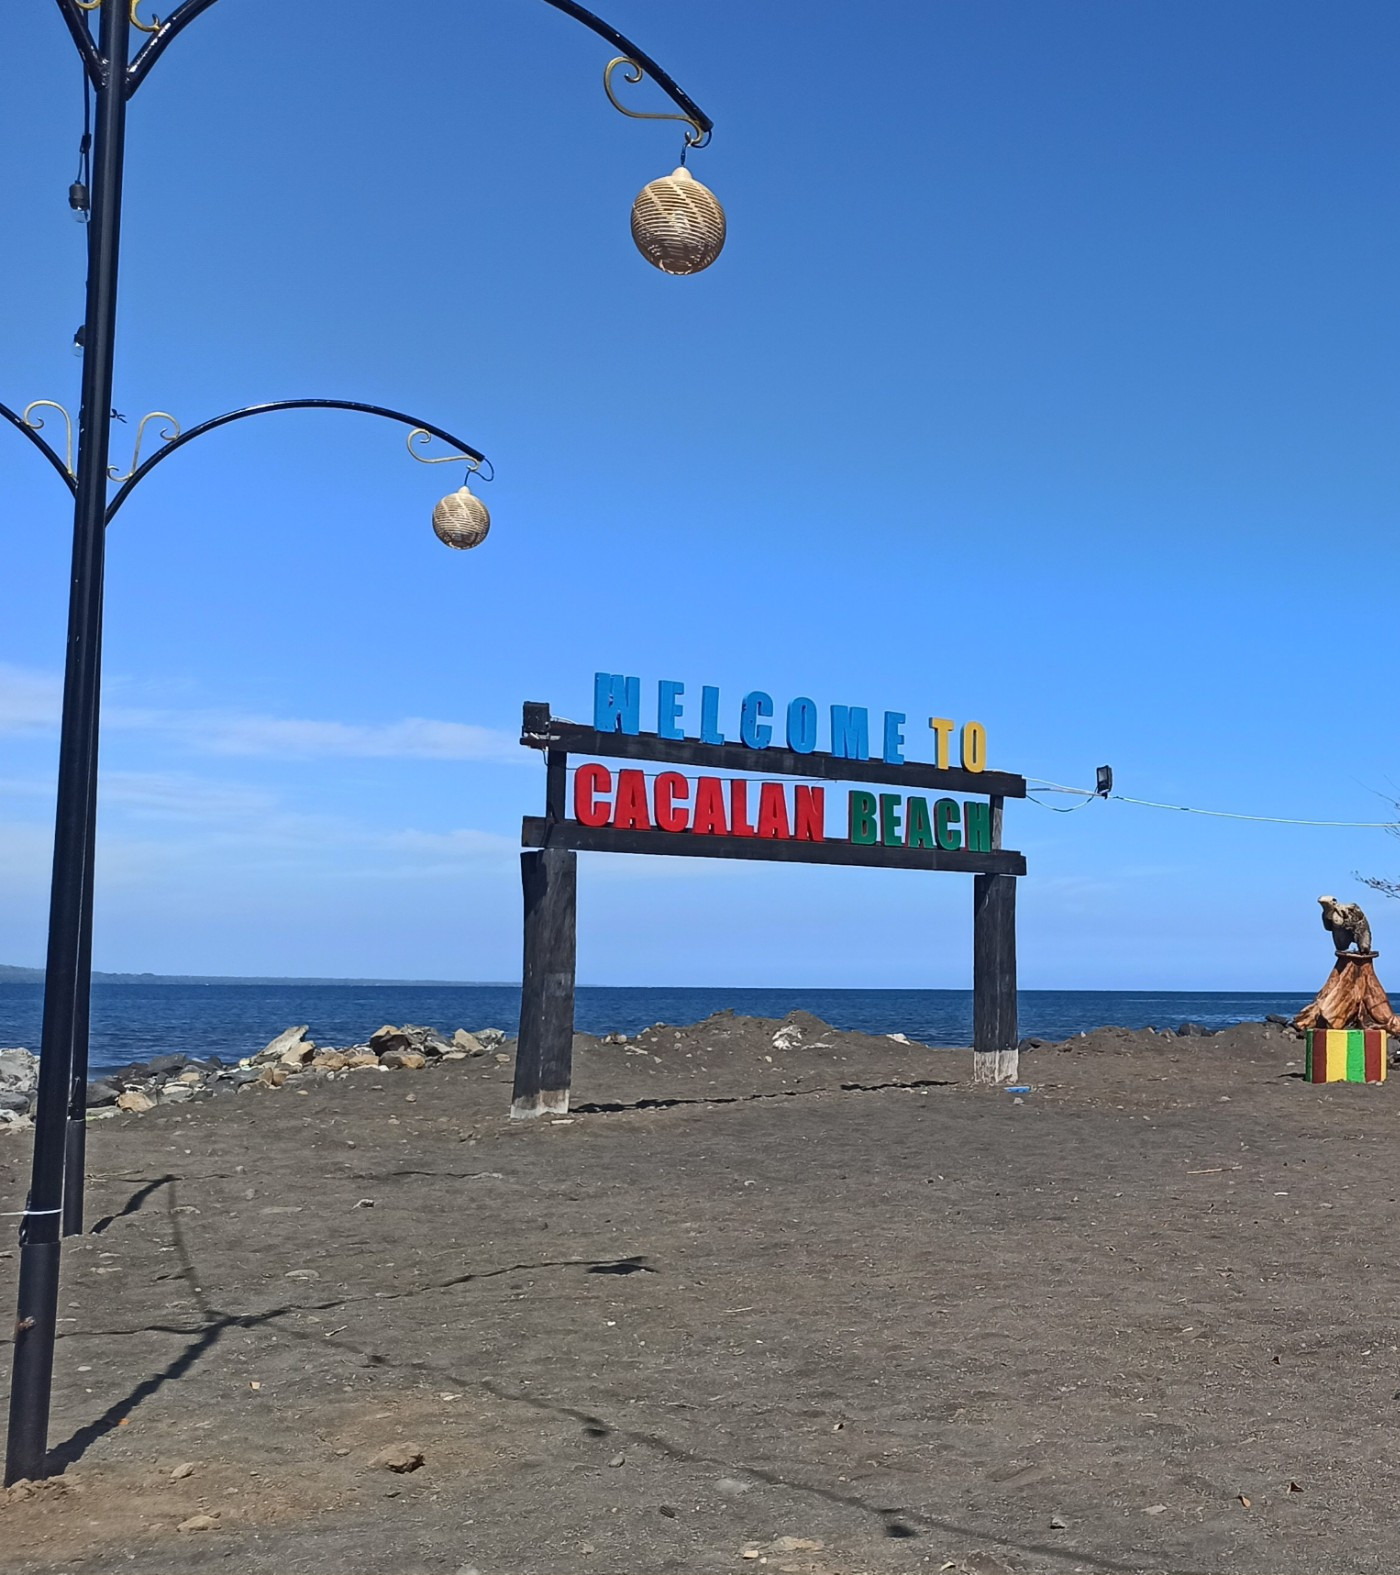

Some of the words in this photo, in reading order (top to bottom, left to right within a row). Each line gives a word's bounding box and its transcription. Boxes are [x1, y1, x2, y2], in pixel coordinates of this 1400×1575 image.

[594, 672, 906, 765] WELCOME
[929, 717, 986, 774] TO
[574, 763, 824, 842] CACALAN
[848, 790, 991, 852] BEACH
